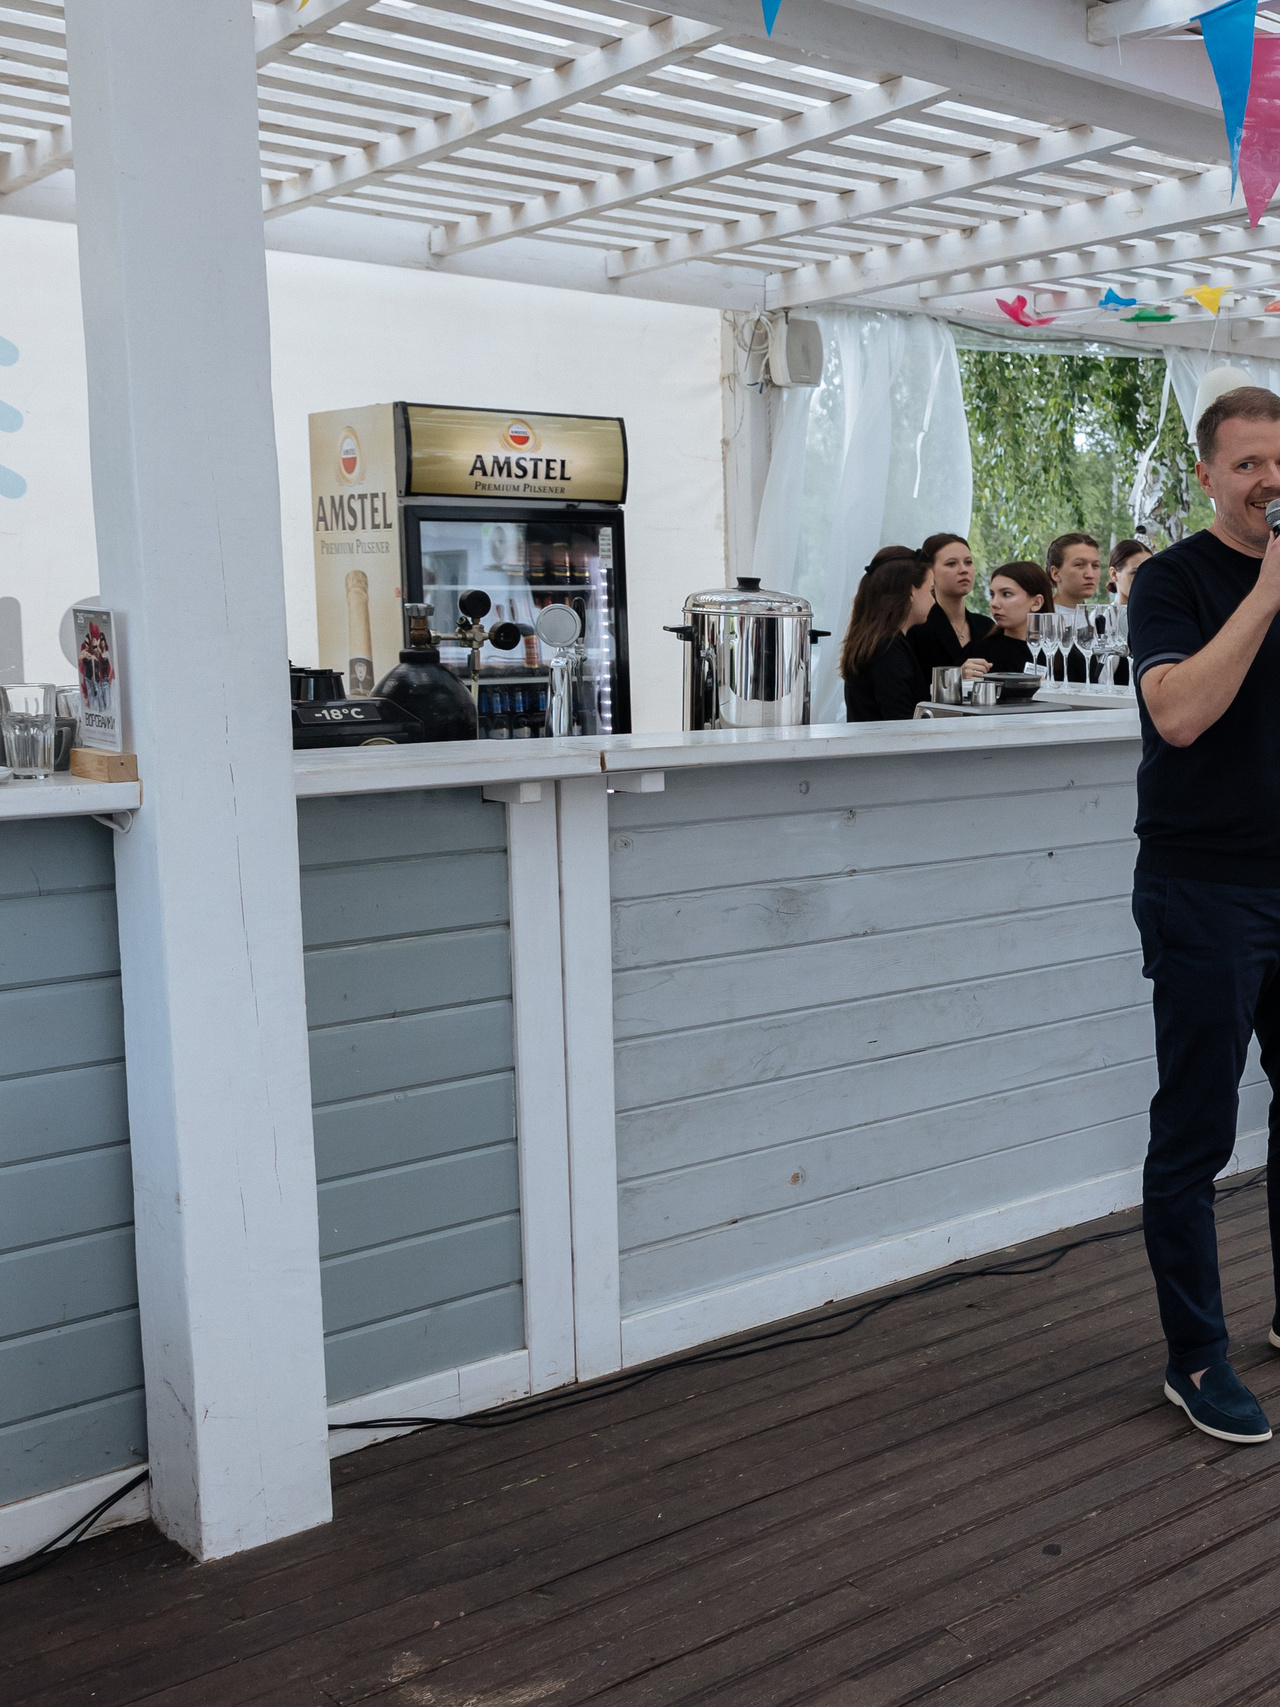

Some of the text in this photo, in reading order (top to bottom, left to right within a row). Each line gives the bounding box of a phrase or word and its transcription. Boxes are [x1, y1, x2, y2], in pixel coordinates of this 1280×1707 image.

[468, 454, 572, 481] AMSTEL
[474, 480, 566, 494] PREMIUM PILSENER
[315, 492, 393, 532] AMSTEL
